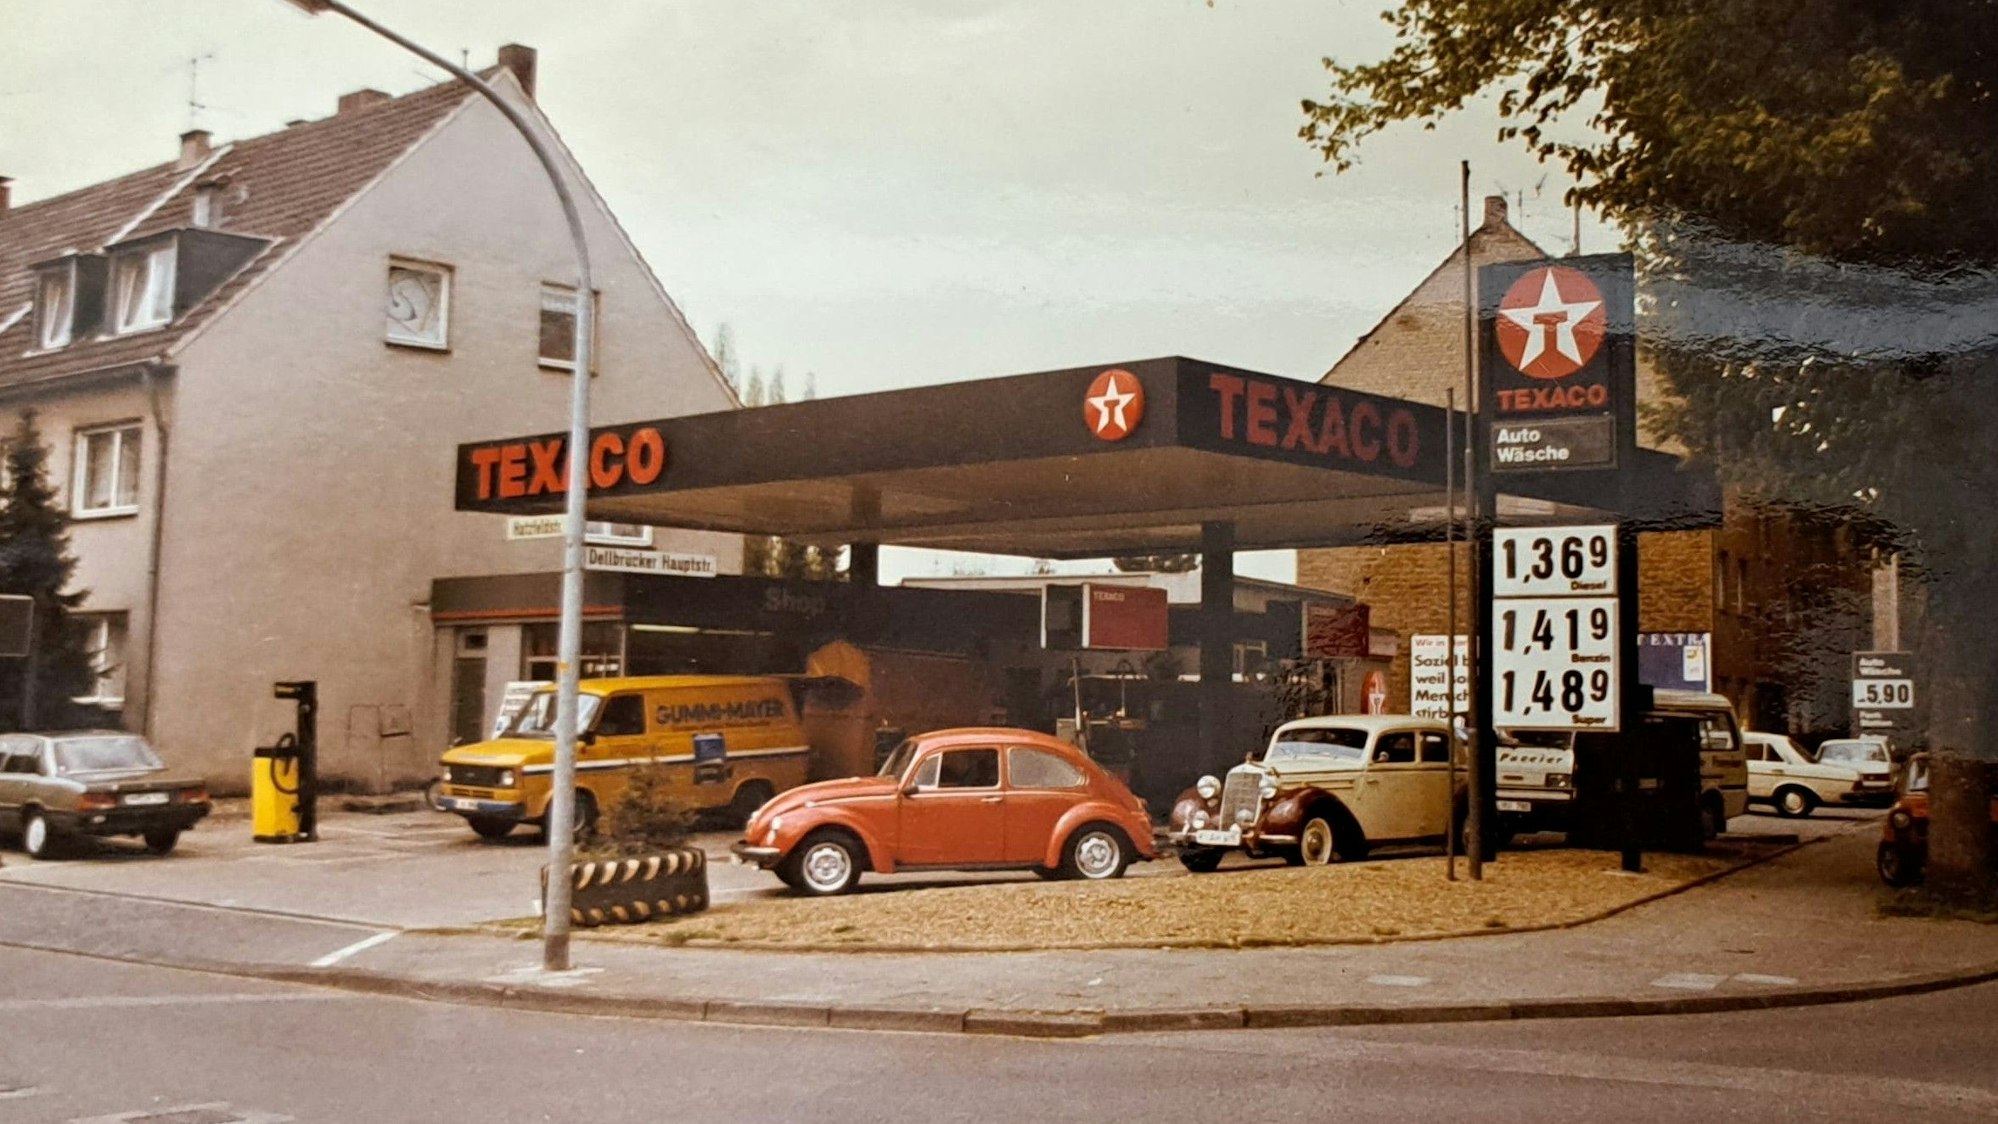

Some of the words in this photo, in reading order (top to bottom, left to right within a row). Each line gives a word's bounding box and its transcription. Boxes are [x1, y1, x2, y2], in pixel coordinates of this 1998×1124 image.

[1497, 384, 1608, 411] TEXACO
[1210, 373, 1420, 468] TEXACO
[1497, 428, 1541, 444] Auto
[1497, 445, 1570, 462] Wäsche
[588, 549, 658, 569] Dellbrücker
[1502, 535, 1608, 583] 1,369
[1570, 580, 1607, 591] Diesel
[1502, 608, 1608, 655] 1,419
[1415, 654, 1459, 667] Sozil
[1571, 653, 1611, 664] Benzin
[1415, 671, 1446, 685] weil
[1502, 669, 1609, 716] 1,489
[1571, 714, 1607, 726] Super
